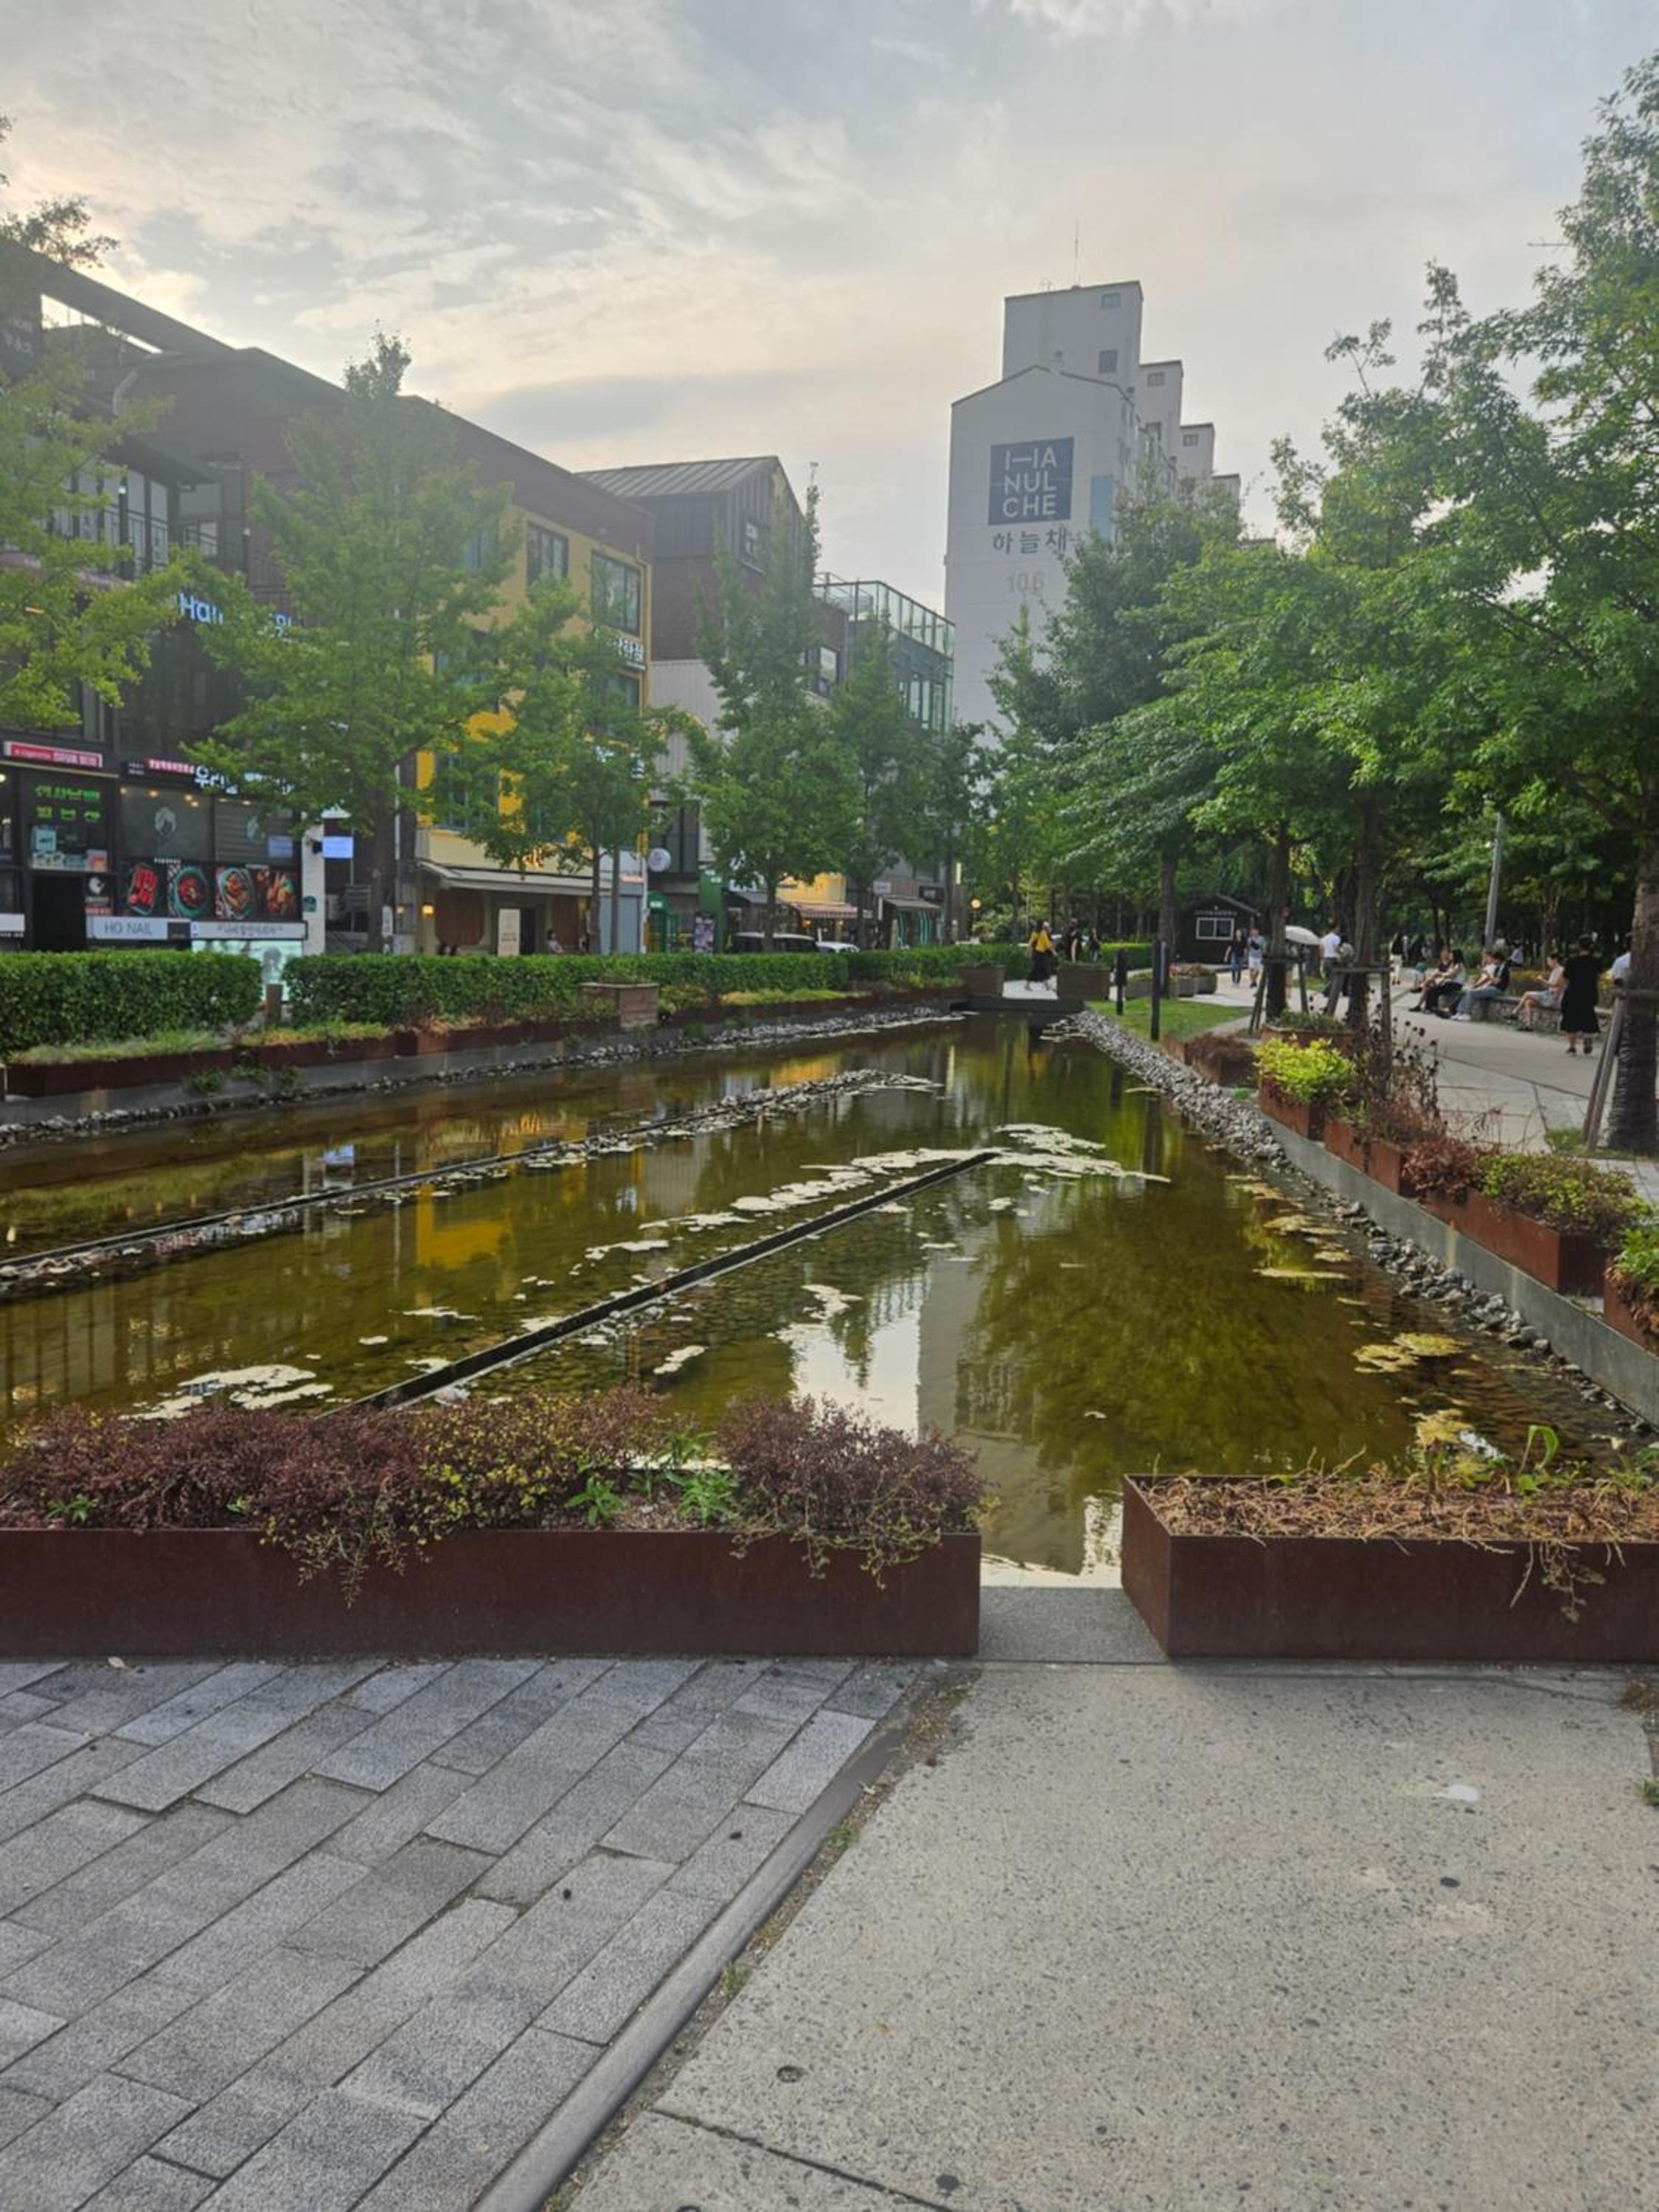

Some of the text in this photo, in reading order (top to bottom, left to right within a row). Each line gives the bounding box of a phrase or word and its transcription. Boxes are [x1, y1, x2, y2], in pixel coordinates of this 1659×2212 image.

[1004, 471, 1056, 495] NUL
[1003, 495, 1057, 518] CHE
[992, 528, 1067, 554] 하늘채
[126, 922, 152, 935] NAIL
